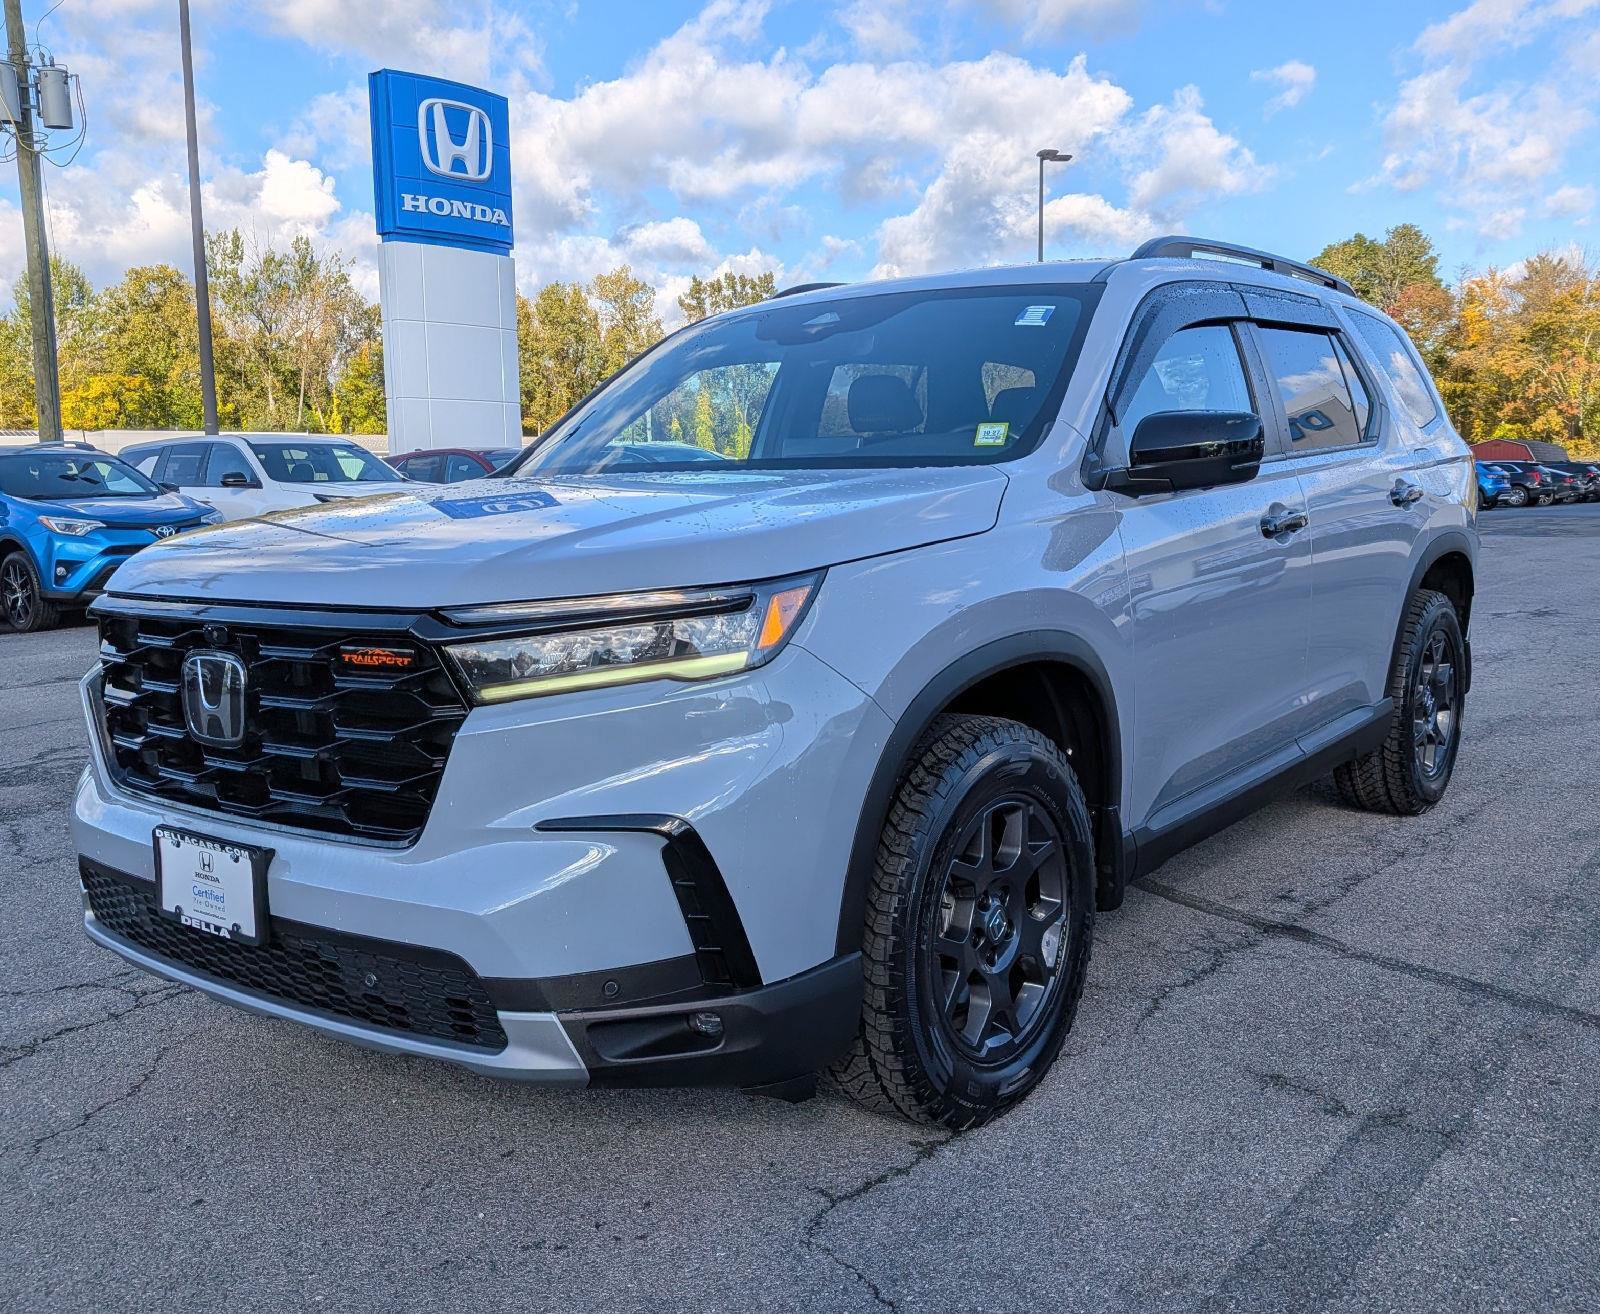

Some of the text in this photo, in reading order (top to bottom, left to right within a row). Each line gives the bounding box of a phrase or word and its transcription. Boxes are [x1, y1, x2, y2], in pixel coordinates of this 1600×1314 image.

[401, 193, 511, 227] HONDA
[341, 653, 412, 667] TRAILSPORT
[156, 829, 250, 860] DELLACARS.COM
[194, 871, 220, 884] HONDA
[192, 885, 225, 904] Certified
[180, 915, 231, 939] DELLA
